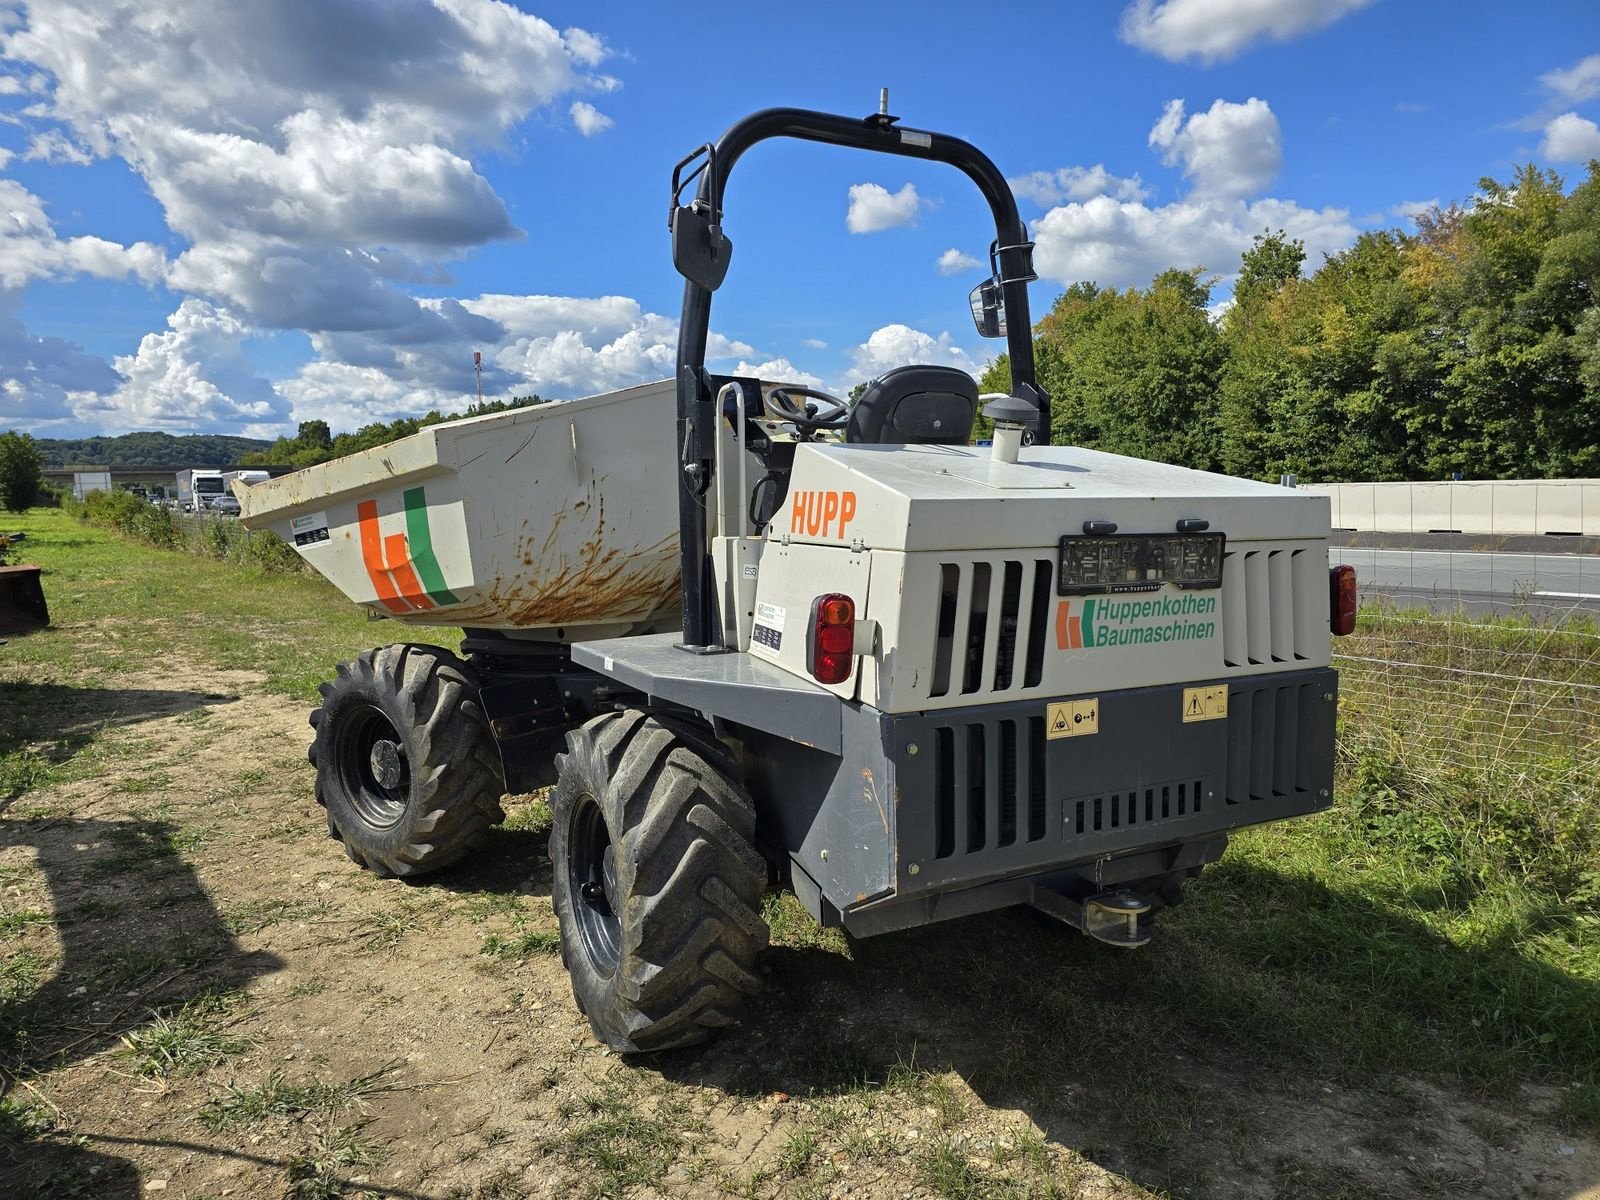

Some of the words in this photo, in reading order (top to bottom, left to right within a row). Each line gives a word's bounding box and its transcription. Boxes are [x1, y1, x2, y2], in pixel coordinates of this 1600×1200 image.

[791, 491, 857, 540] HUPP
[1096, 594, 1216, 624] Huppenkothen
[1096, 620, 1215, 647] Baumaschinen
